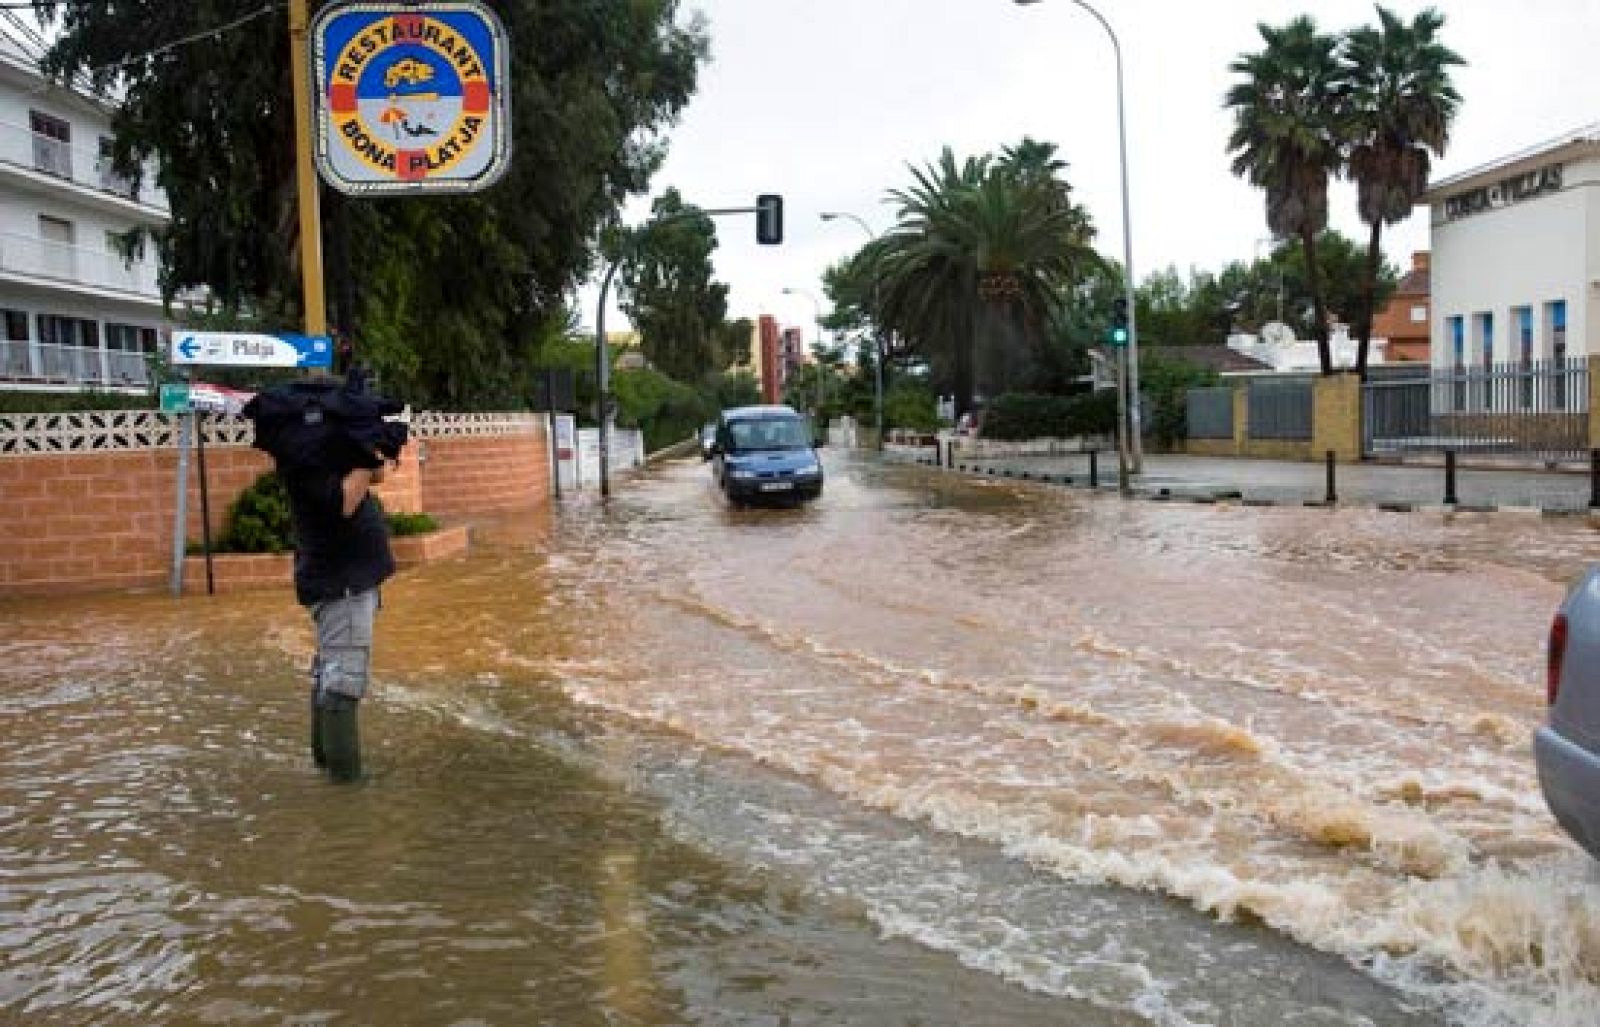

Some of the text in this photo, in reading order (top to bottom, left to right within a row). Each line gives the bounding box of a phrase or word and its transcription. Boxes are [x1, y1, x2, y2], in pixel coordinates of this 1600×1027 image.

[339, 22, 482, 82] RESTAURANT
[341, 116, 482, 172] BONA PLATJA
